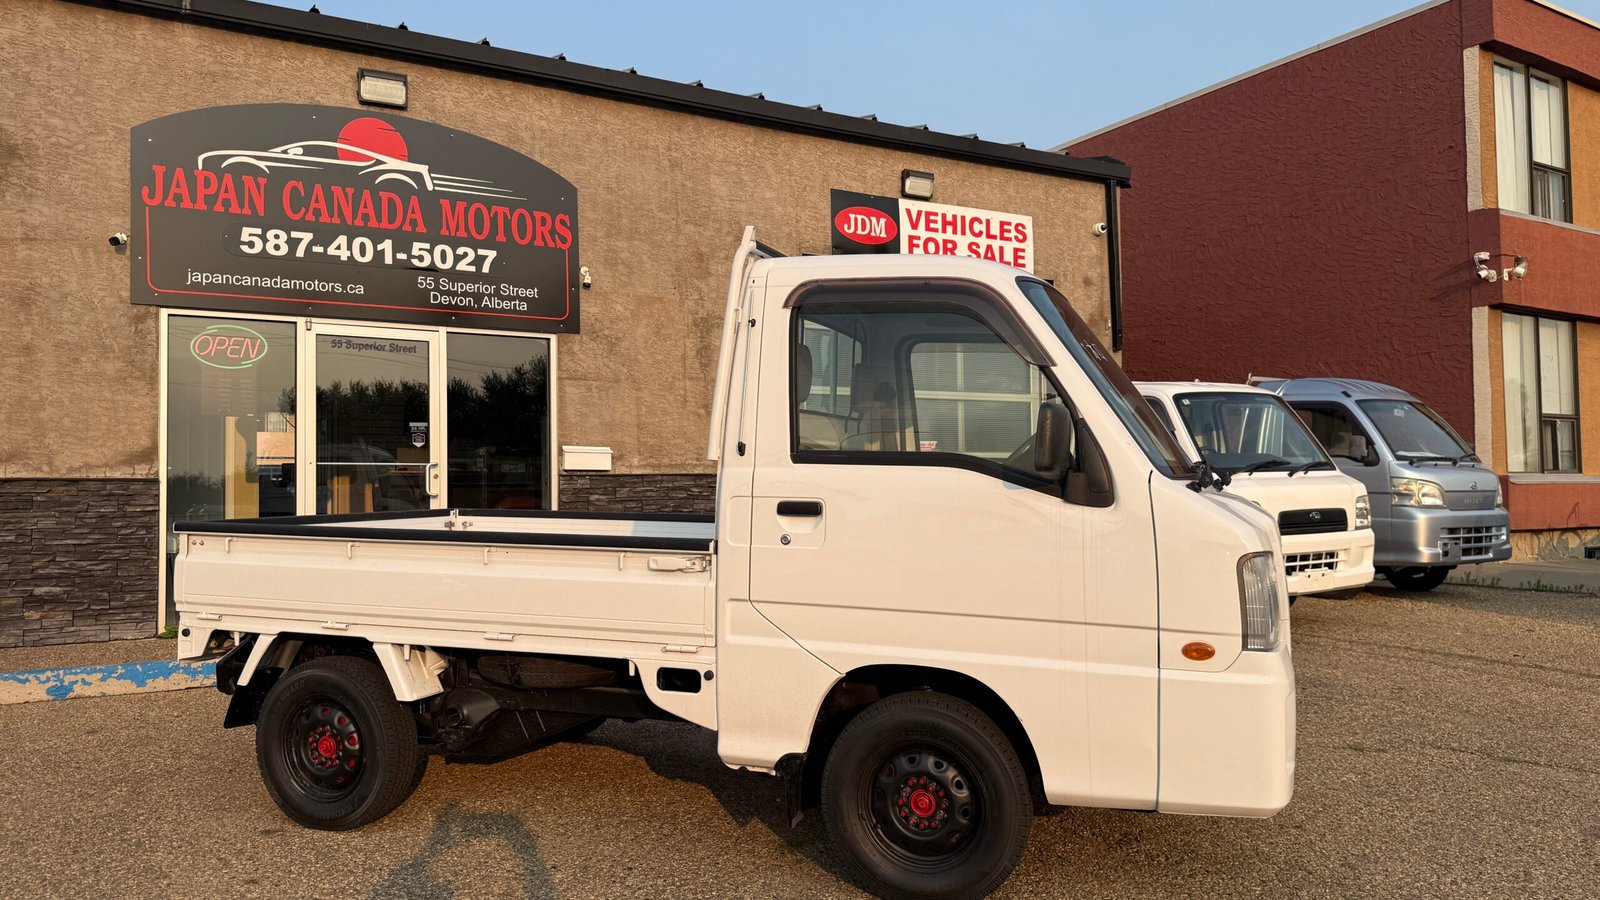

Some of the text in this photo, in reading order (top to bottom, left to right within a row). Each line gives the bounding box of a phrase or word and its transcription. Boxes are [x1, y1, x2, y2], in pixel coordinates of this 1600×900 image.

[141, 164, 573, 250] JAPAN CANADA MOTORS
[843, 213, 887, 237] JDM
[905, 208, 1028, 244] VEHICLES
[239, 226, 498, 274] 587-401-5027
[907, 235, 1026, 268] FOR SALE
[186, 269, 365, 295] japancanadamotors.ca
[417, 276, 539, 299] 55 Superior Street
[430, 291, 528, 311] Devon, Alberta
[195, 335, 261, 359] OPEN
[331, 339, 417, 354] 55 Superior Street
